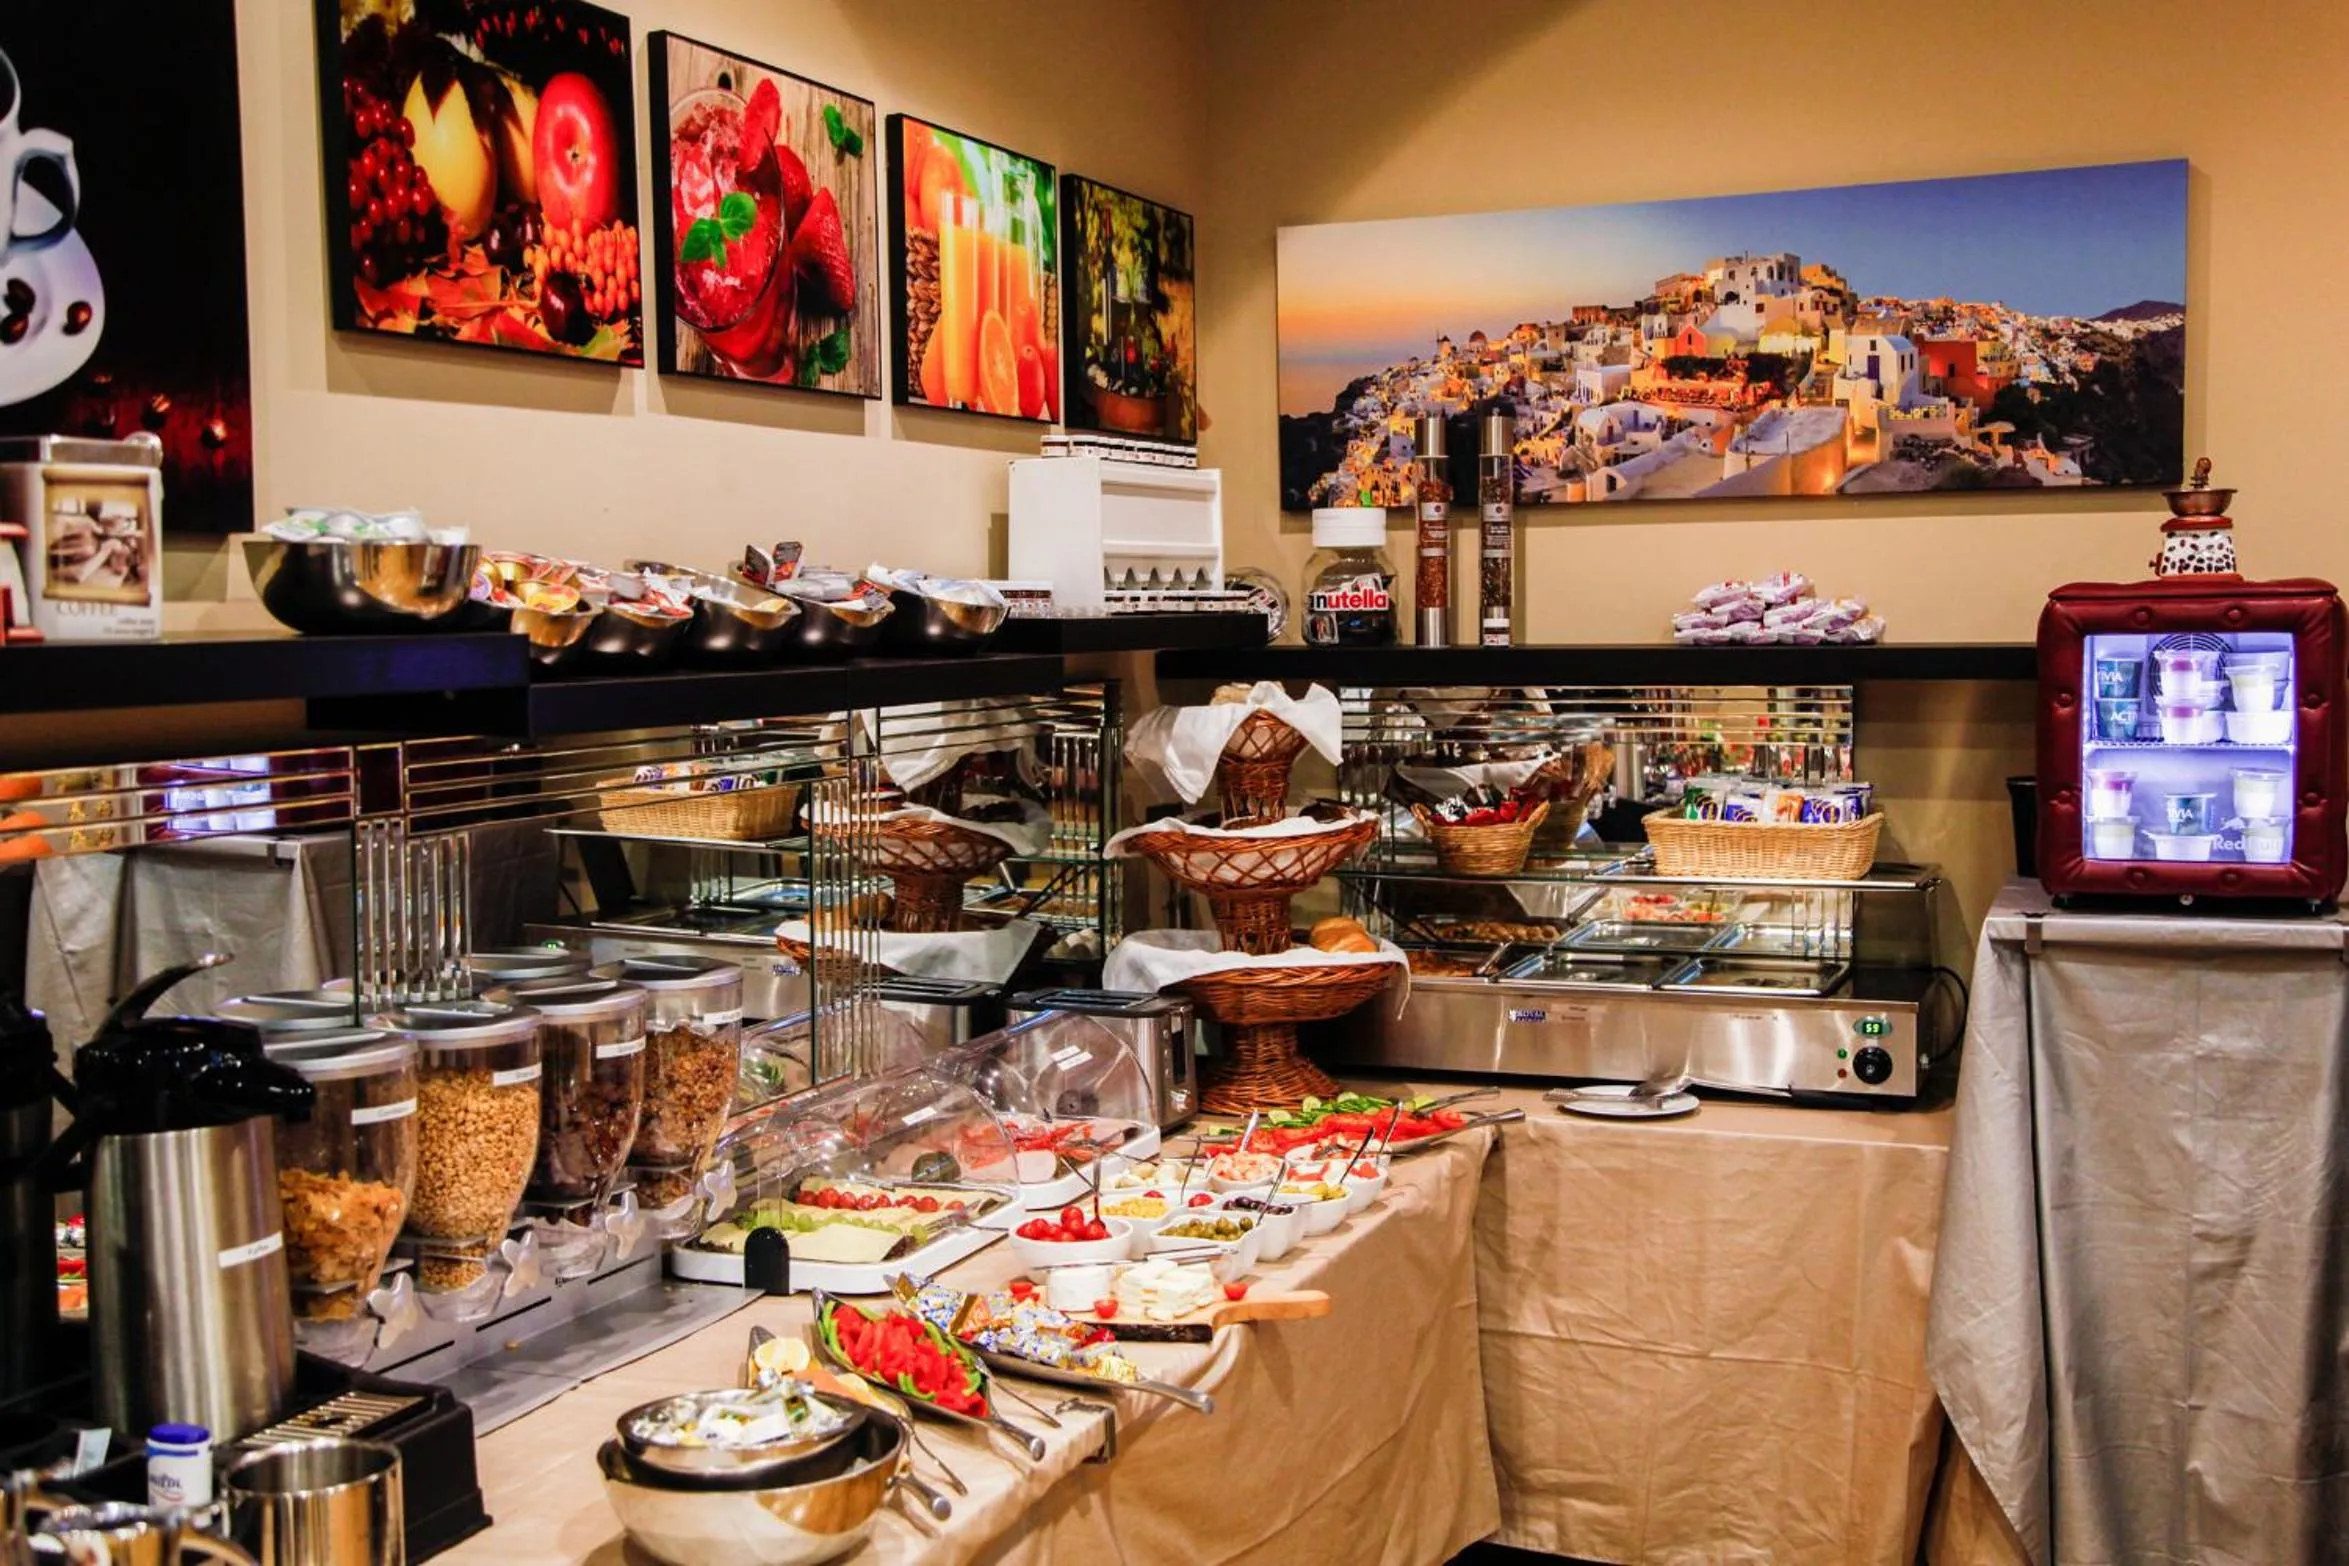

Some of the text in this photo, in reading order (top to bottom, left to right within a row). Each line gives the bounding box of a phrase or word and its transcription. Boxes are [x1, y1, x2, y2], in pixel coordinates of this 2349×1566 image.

[1316, 588, 1387, 609] nutella
[56, 601, 118, 616] COFFEE
[2213, 835, 2245, 850] Red
